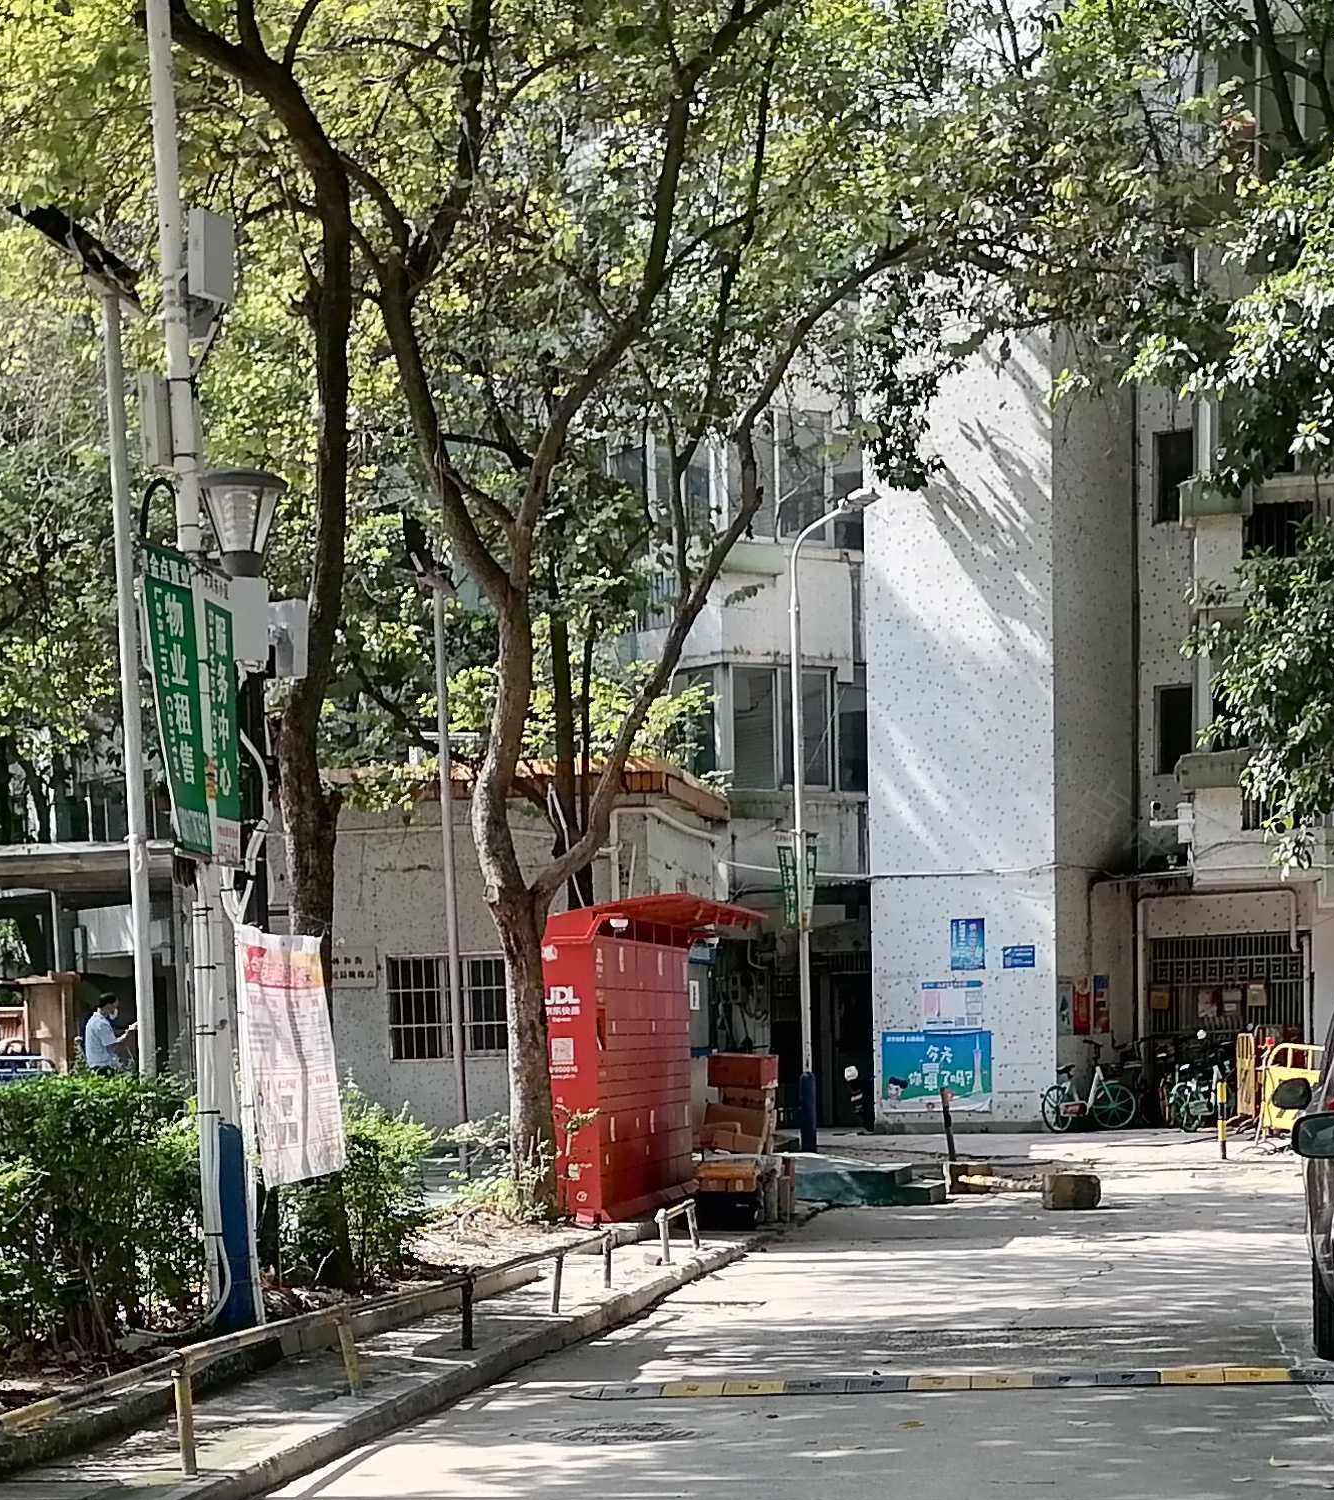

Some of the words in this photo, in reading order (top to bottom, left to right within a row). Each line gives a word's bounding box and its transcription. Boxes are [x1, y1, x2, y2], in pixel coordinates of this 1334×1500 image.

[165, 591, 195, 784] 物业租售
[215, 614, 232, 796] 服务中心
[544, 986, 580, 1005] JDL
[926, 1044, 954, 1064] 今天
